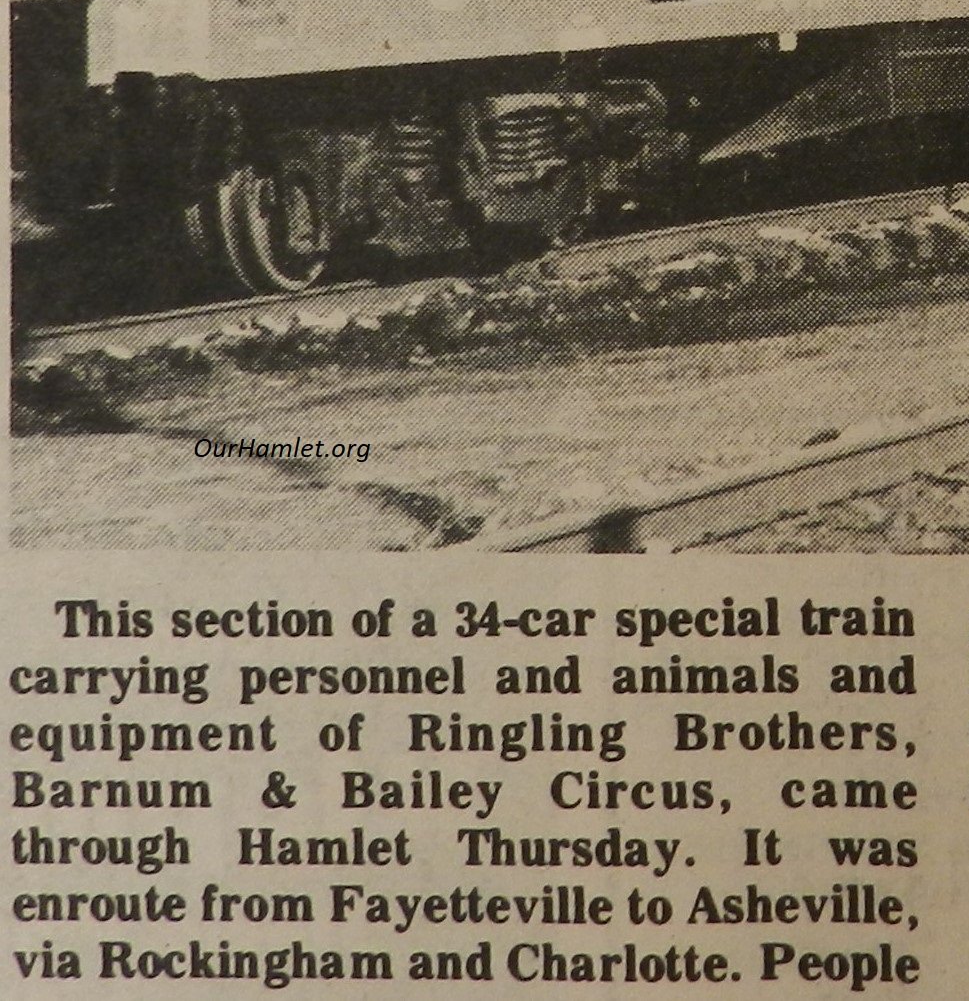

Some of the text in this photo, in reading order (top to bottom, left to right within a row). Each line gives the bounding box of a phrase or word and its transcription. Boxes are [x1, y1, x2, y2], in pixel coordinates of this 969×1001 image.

[54, 595, 916, 648] This section of a 34-car special train
[9, 654, 917, 705] carrying personnel and animals and
[10, 710, 916, 763] equipment of Ringling Brothers,
[12, 769, 918, 820] Barnum & Bailey Circus, came
[11, 826, 918, 878] through Hamlet Thursday. It was
[12, 883, 919, 934] enroute from Fayetteville to Asheville,
[14, 940, 921, 993] via Rockingham and Charlotte. People
